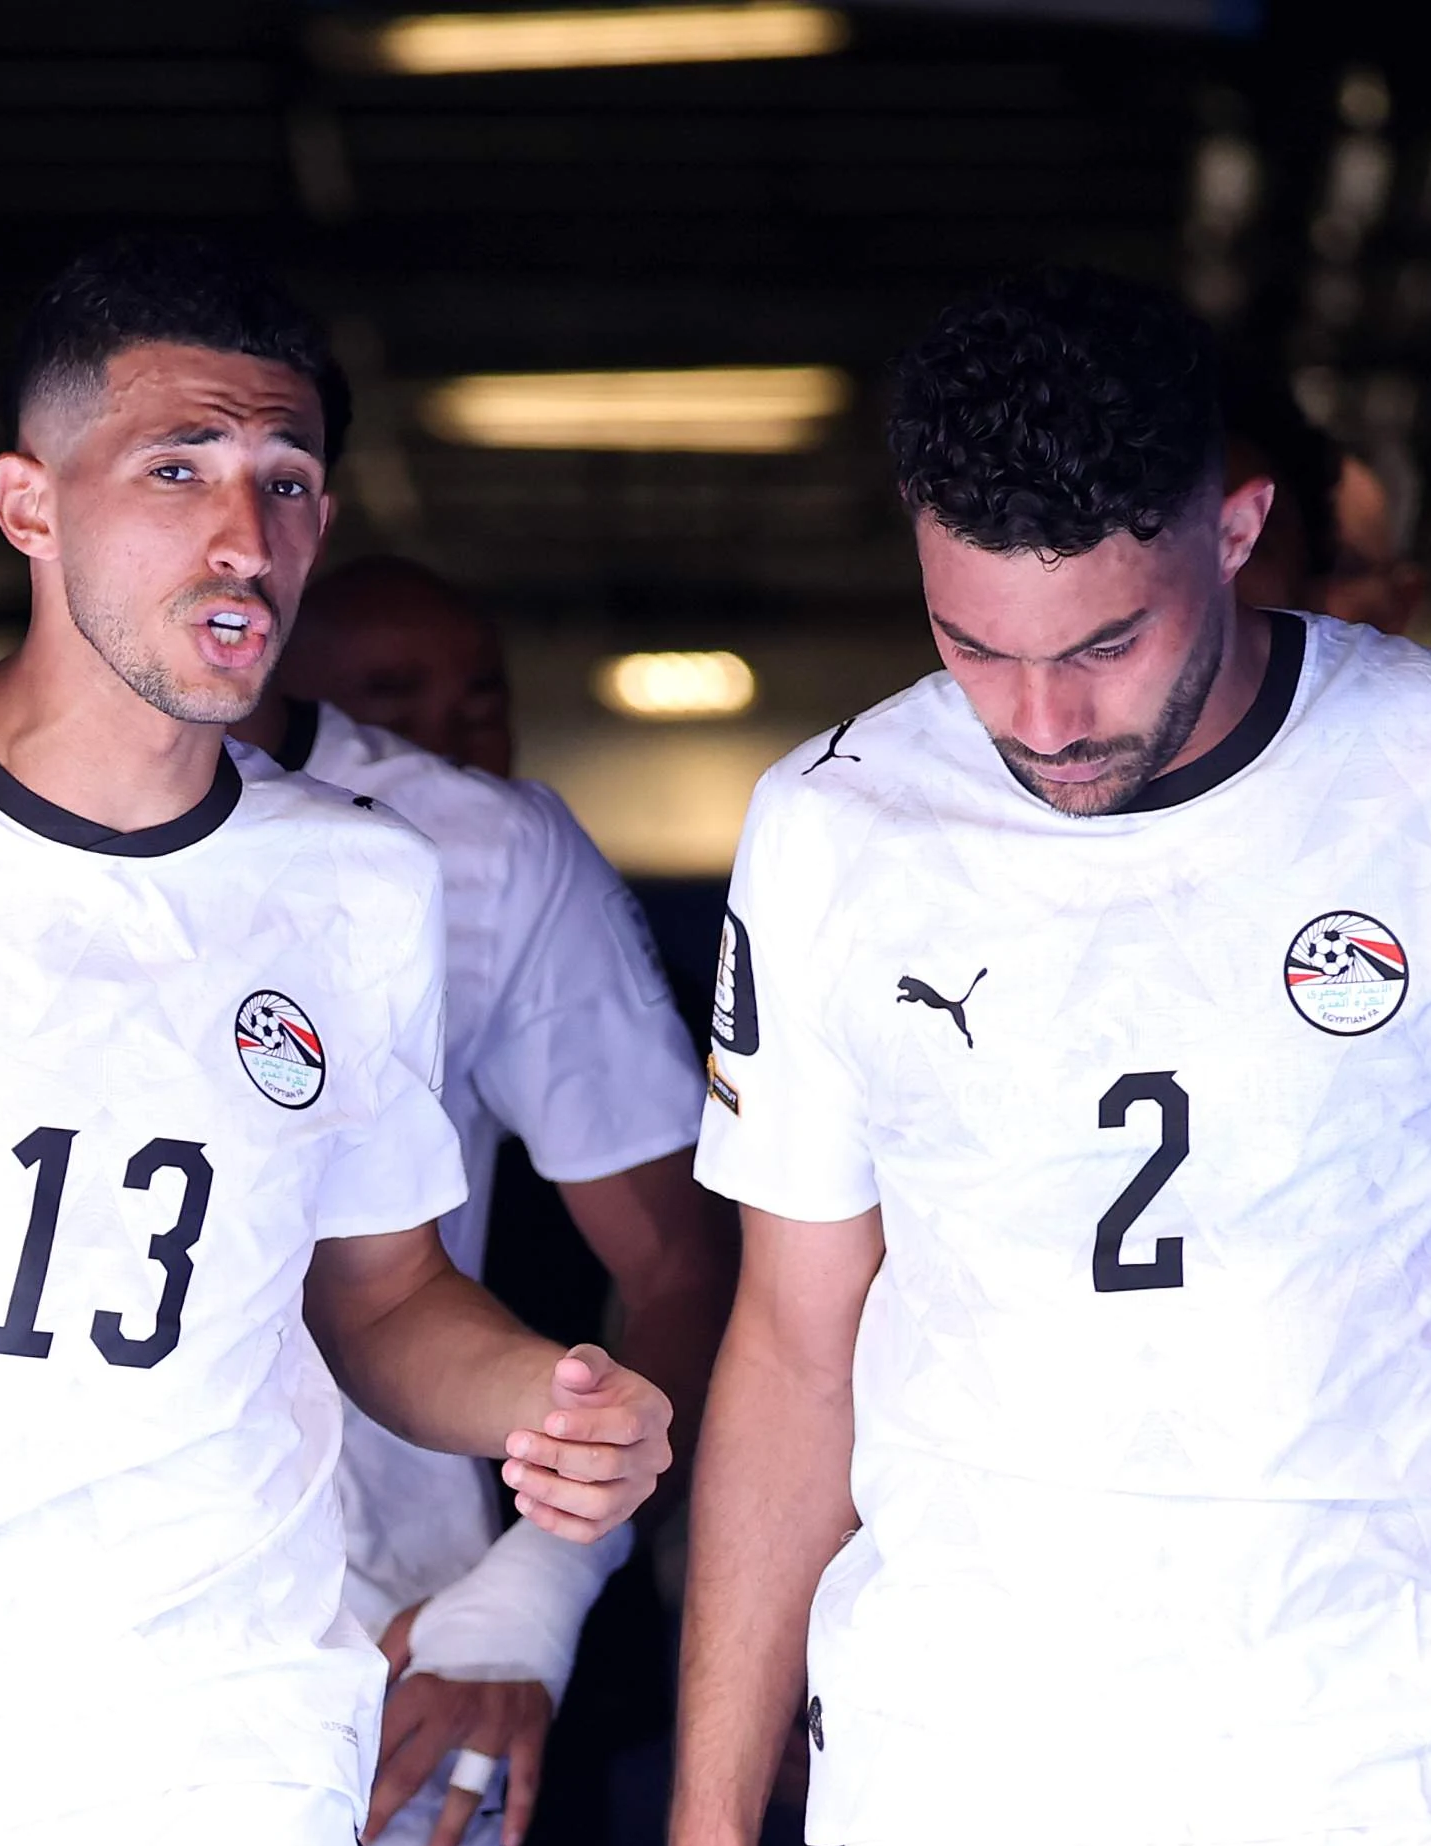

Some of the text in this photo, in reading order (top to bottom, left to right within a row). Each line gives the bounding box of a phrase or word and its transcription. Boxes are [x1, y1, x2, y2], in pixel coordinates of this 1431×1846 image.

[1321, 1008, 1381, 1025] EGYPTIAN FA
[1092, 1071, 1190, 1293] 2
